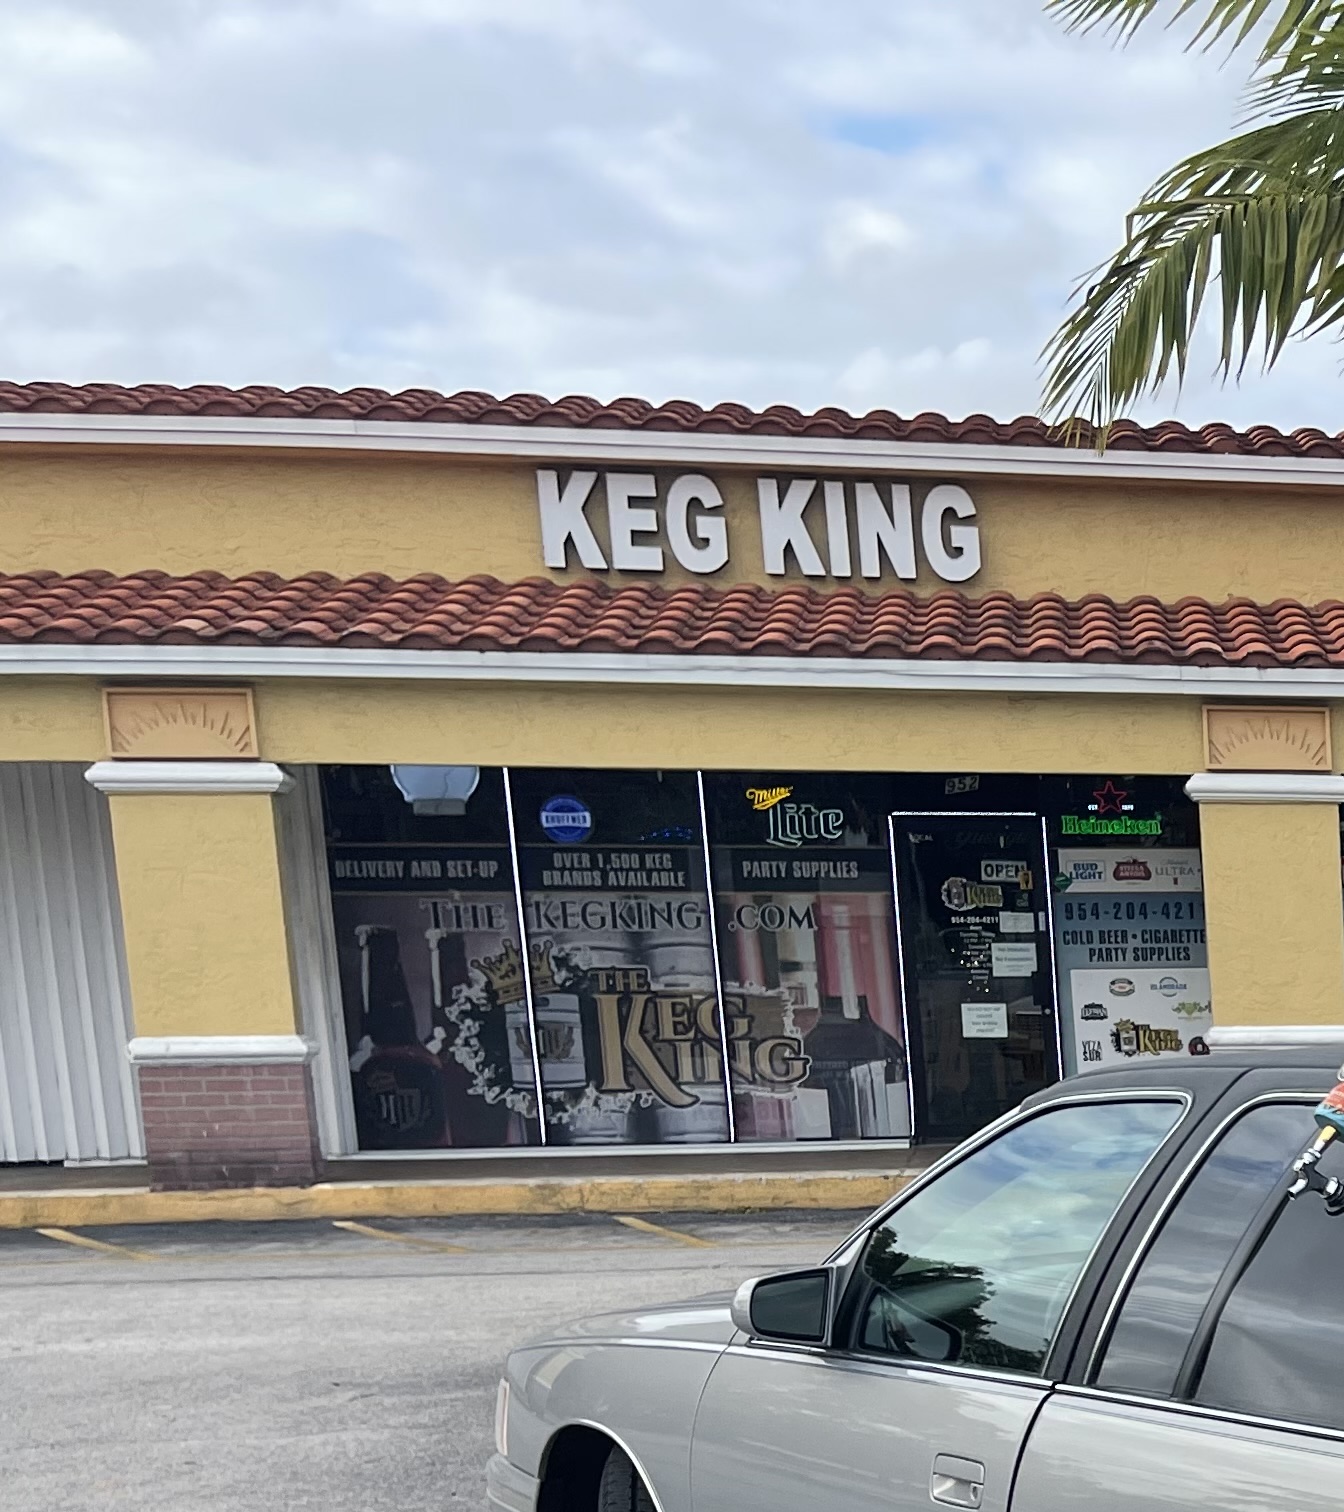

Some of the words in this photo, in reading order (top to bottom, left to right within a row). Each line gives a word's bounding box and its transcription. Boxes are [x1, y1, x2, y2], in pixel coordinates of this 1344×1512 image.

[536, 467, 730, 575] KEG
[756, 477, 982, 584] KING
[946, 776, 978, 794] 952
[746, 785, 794, 811] Miller
[766, 803, 844, 848] Lite
[1061, 815, 1163, 836] Heineken
[335, 860, 405, 879] DELIVERY
[410, 861, 442, 878] AND
[447, 860, 499, 878] SET-UP
[553, 853, 592, 869] OVER
[596, 853, 640, 869] 1,500
[645, 853, 673, 870] KEG
[742, 861, 787, 879] PARTY
[792, 861, 859, 879] SUPPLIES
[1072, 862, 1099, 871] BUD
[542, 869, 601, 887] BRANDS
[607, 871, 686, 888] AVAILABLE
[983, 863, 1026, 879] OPEN
[1069, 871, 1104, 881] LIGHT
[1154, 866, 1195, 877] ULTRA
[1062, 930, 1095, 946] COLD
[1099, 929, 1129, 945] BEER
[1088, 947, 1128, 963] PARTY
[1132, 946, 1191, 962] SUPPLIES
[590, 970, 651, 992] THE
